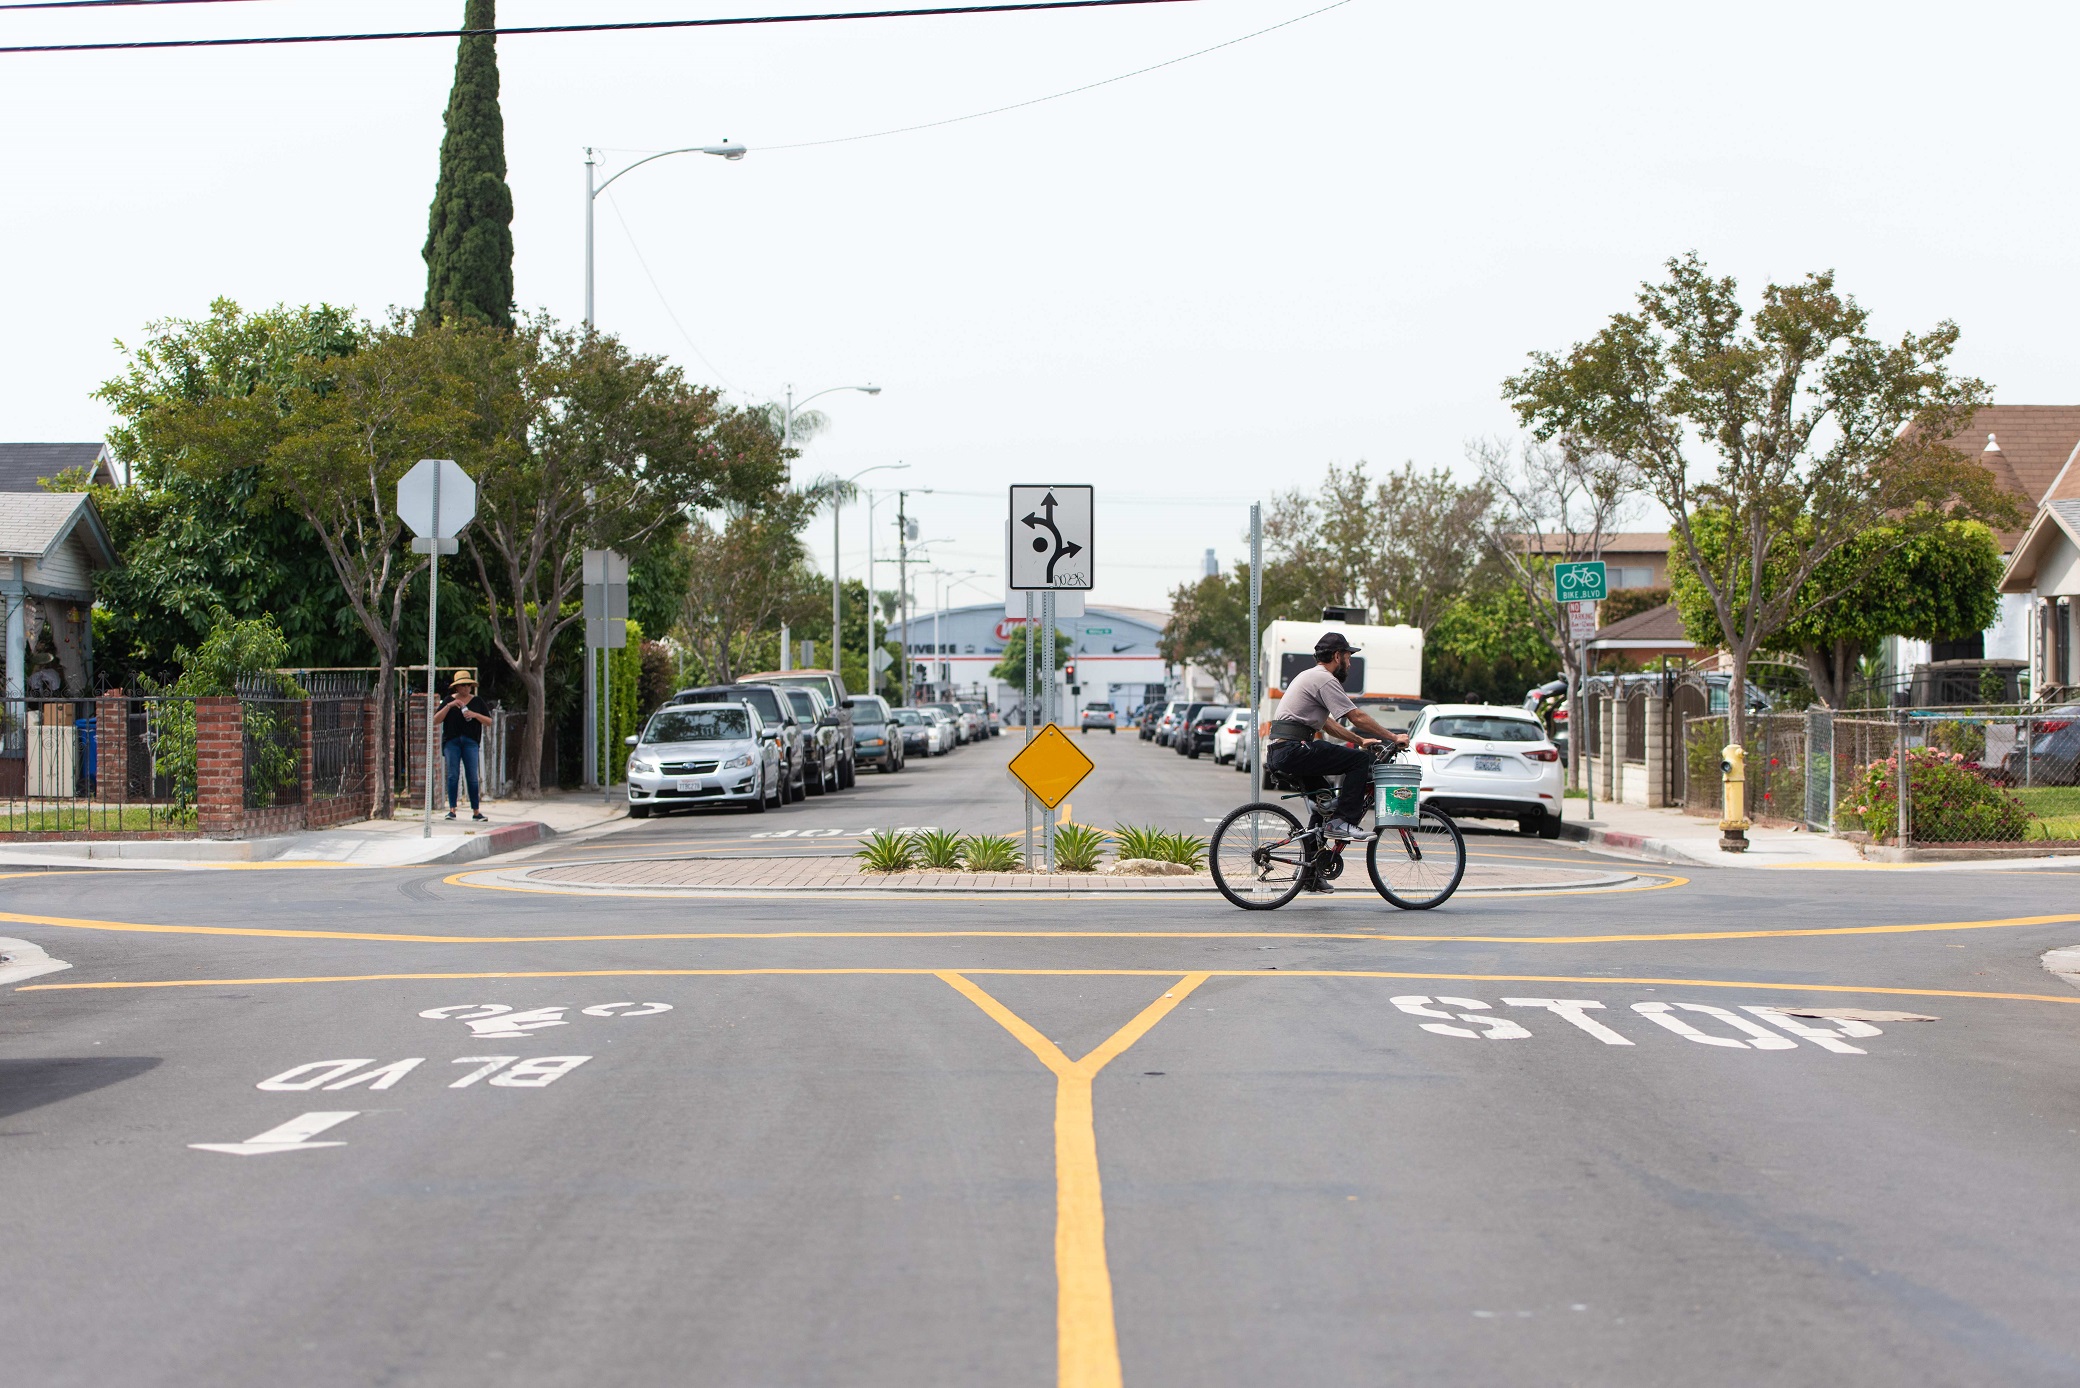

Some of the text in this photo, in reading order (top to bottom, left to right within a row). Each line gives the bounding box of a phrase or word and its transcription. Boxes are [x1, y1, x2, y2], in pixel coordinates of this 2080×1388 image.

[1563, 590, 1600, 599] BIKE BLVD
[1570, 602, 1579, 611] NO
[1389, 995, 1884, 1054] STOP
[256, 1055, 593, 1091] BLVD
